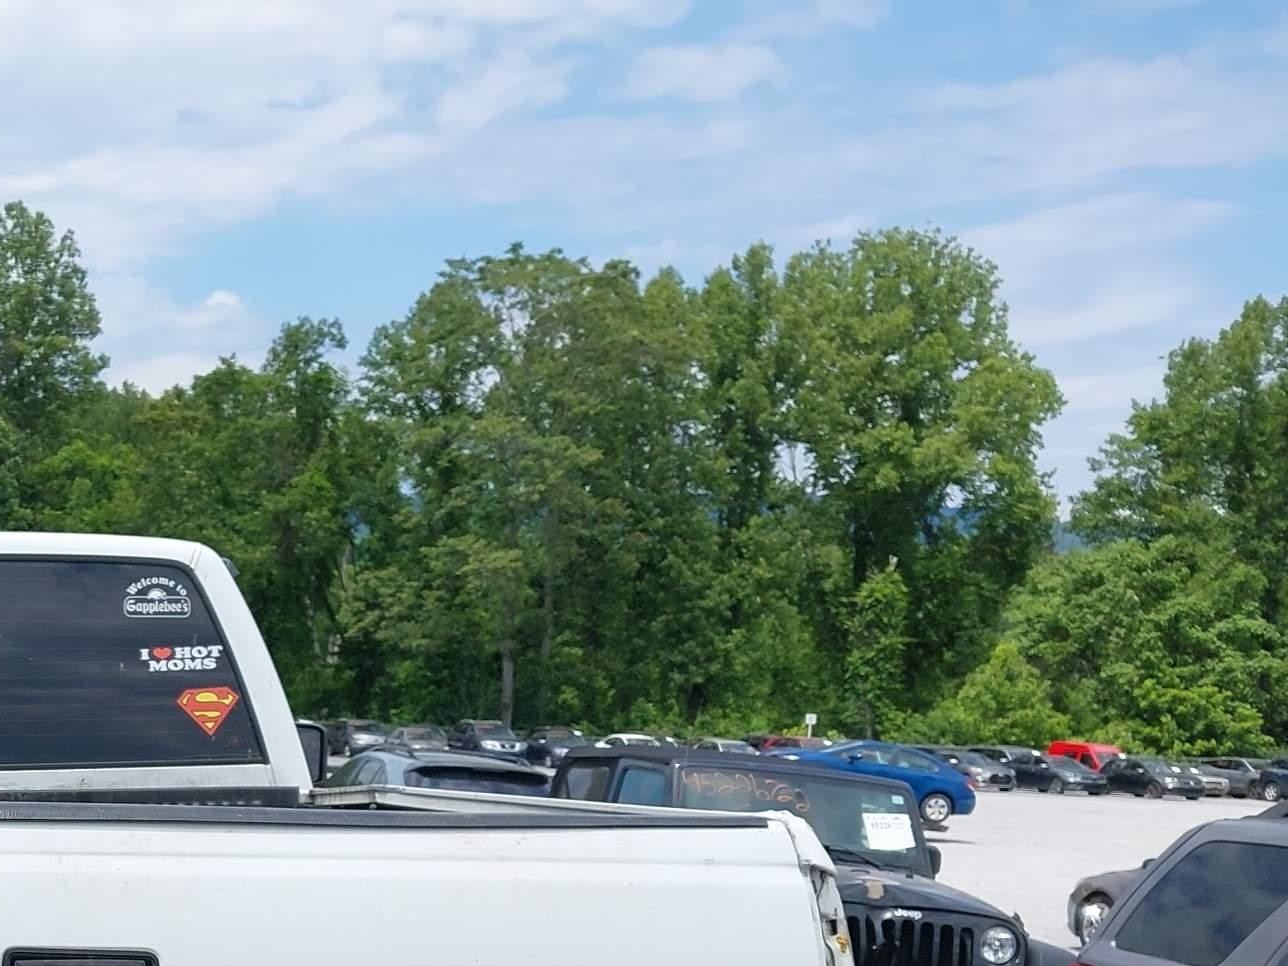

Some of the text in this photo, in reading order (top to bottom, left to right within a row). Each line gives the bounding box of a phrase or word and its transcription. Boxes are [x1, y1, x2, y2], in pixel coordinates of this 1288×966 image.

[126, 576, 188, 596] Welcome to
[125, 600, 189, 615] Gapplebee's
[139, 645, 224, 661] I HOT
[148, 658, 217, 672] MOMS
[894, 908, 923, 920] Jeep
